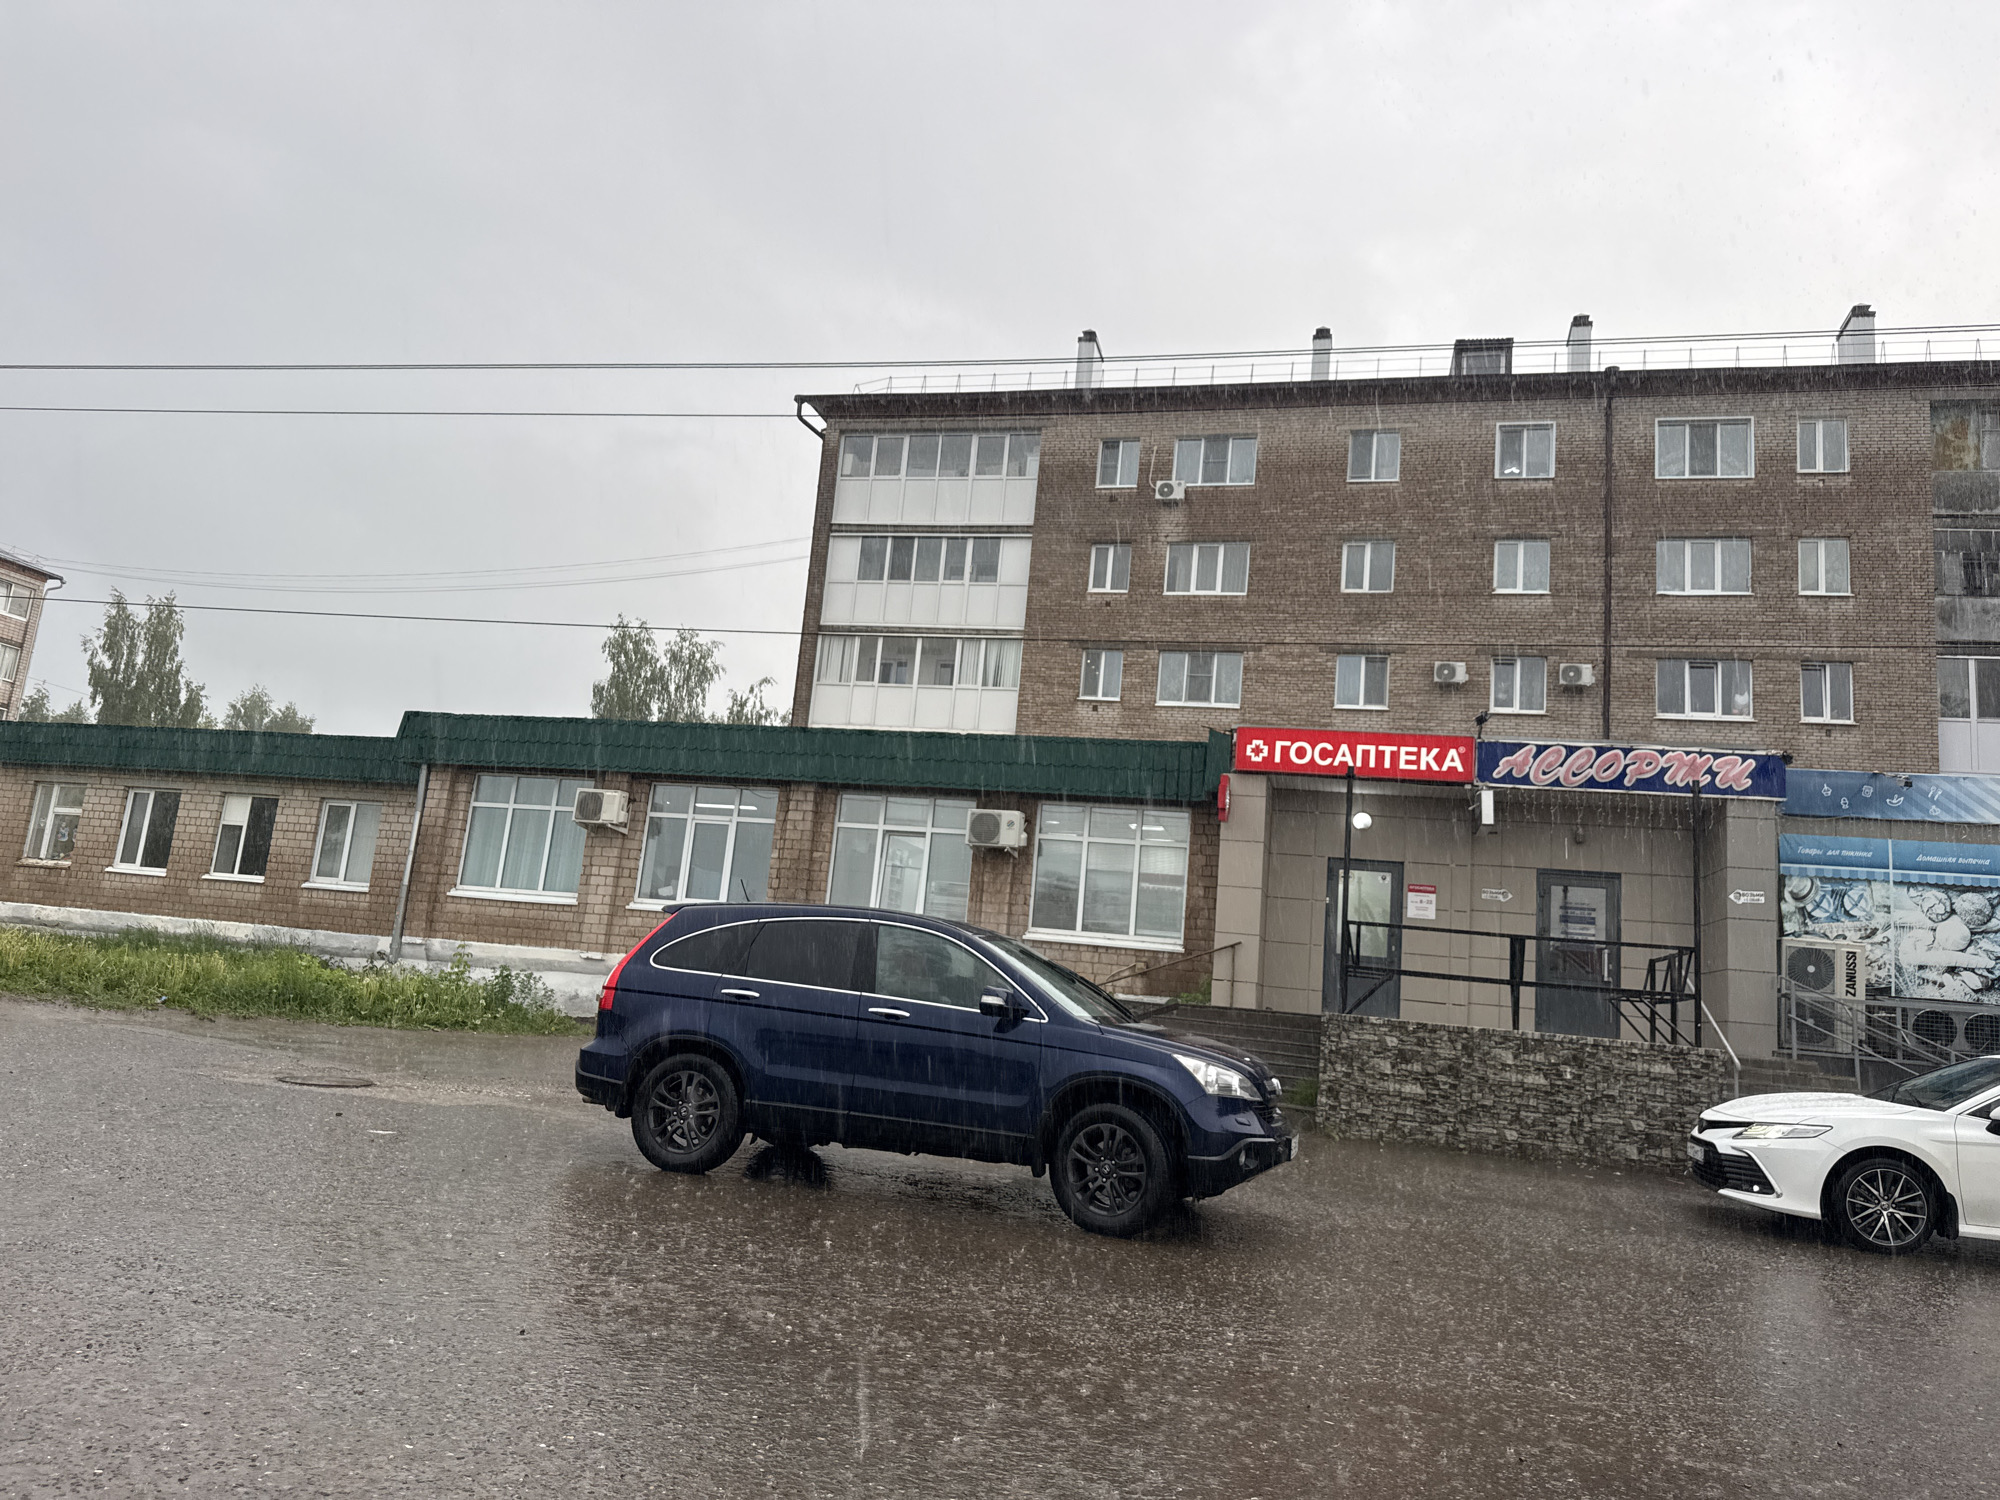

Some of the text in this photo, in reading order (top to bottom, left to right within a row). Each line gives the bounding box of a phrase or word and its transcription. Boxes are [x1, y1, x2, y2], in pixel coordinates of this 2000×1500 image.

[1273, 740, 1465, 773] ГОСАПТЕКА
[1492, 745, 1756, 791] АССОРТИ
[1797, 845, 1823, 856] Товары
[1841, 849, 1873, 858] пикника
[1916, 853, 1991, 865] Домашняя выпечка
[1845, 951, 1857, 997] ZANUSSI
